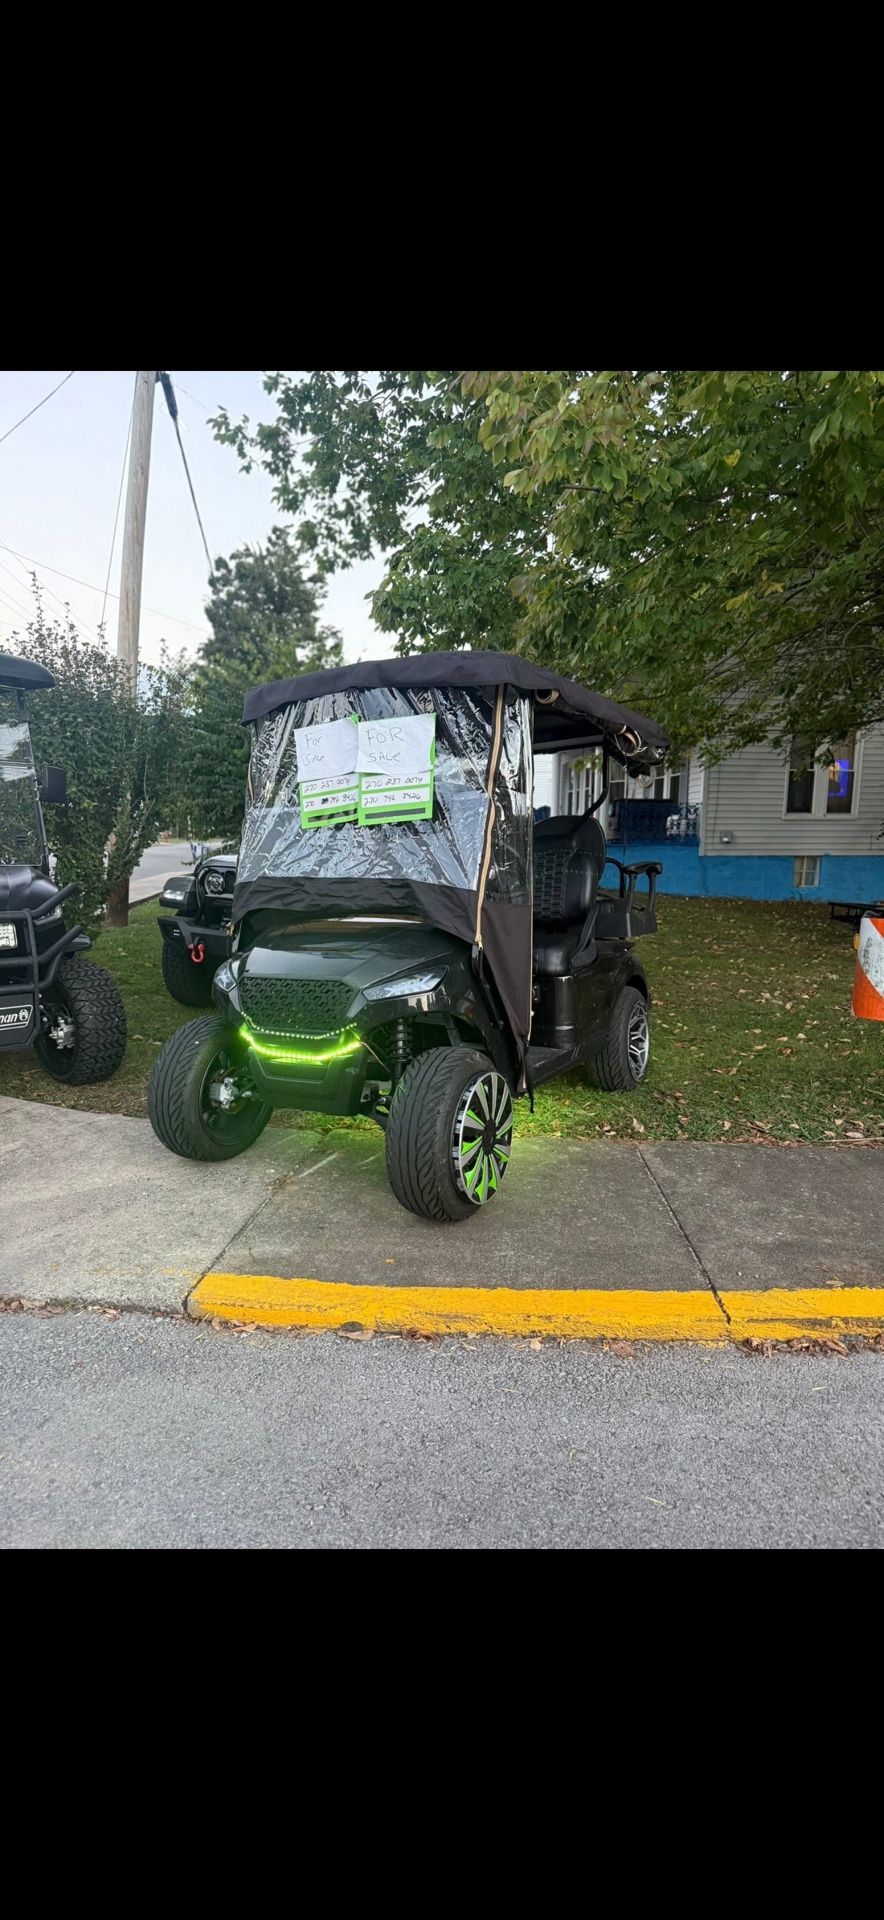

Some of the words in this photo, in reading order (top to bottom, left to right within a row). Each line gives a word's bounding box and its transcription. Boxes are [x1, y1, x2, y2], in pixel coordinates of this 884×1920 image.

[365, 726, 404, 746] FOR
[364, 779, 383, 790] 270
[385, 777, 401, 786] 237
[383, 794, 396, 803] 746
